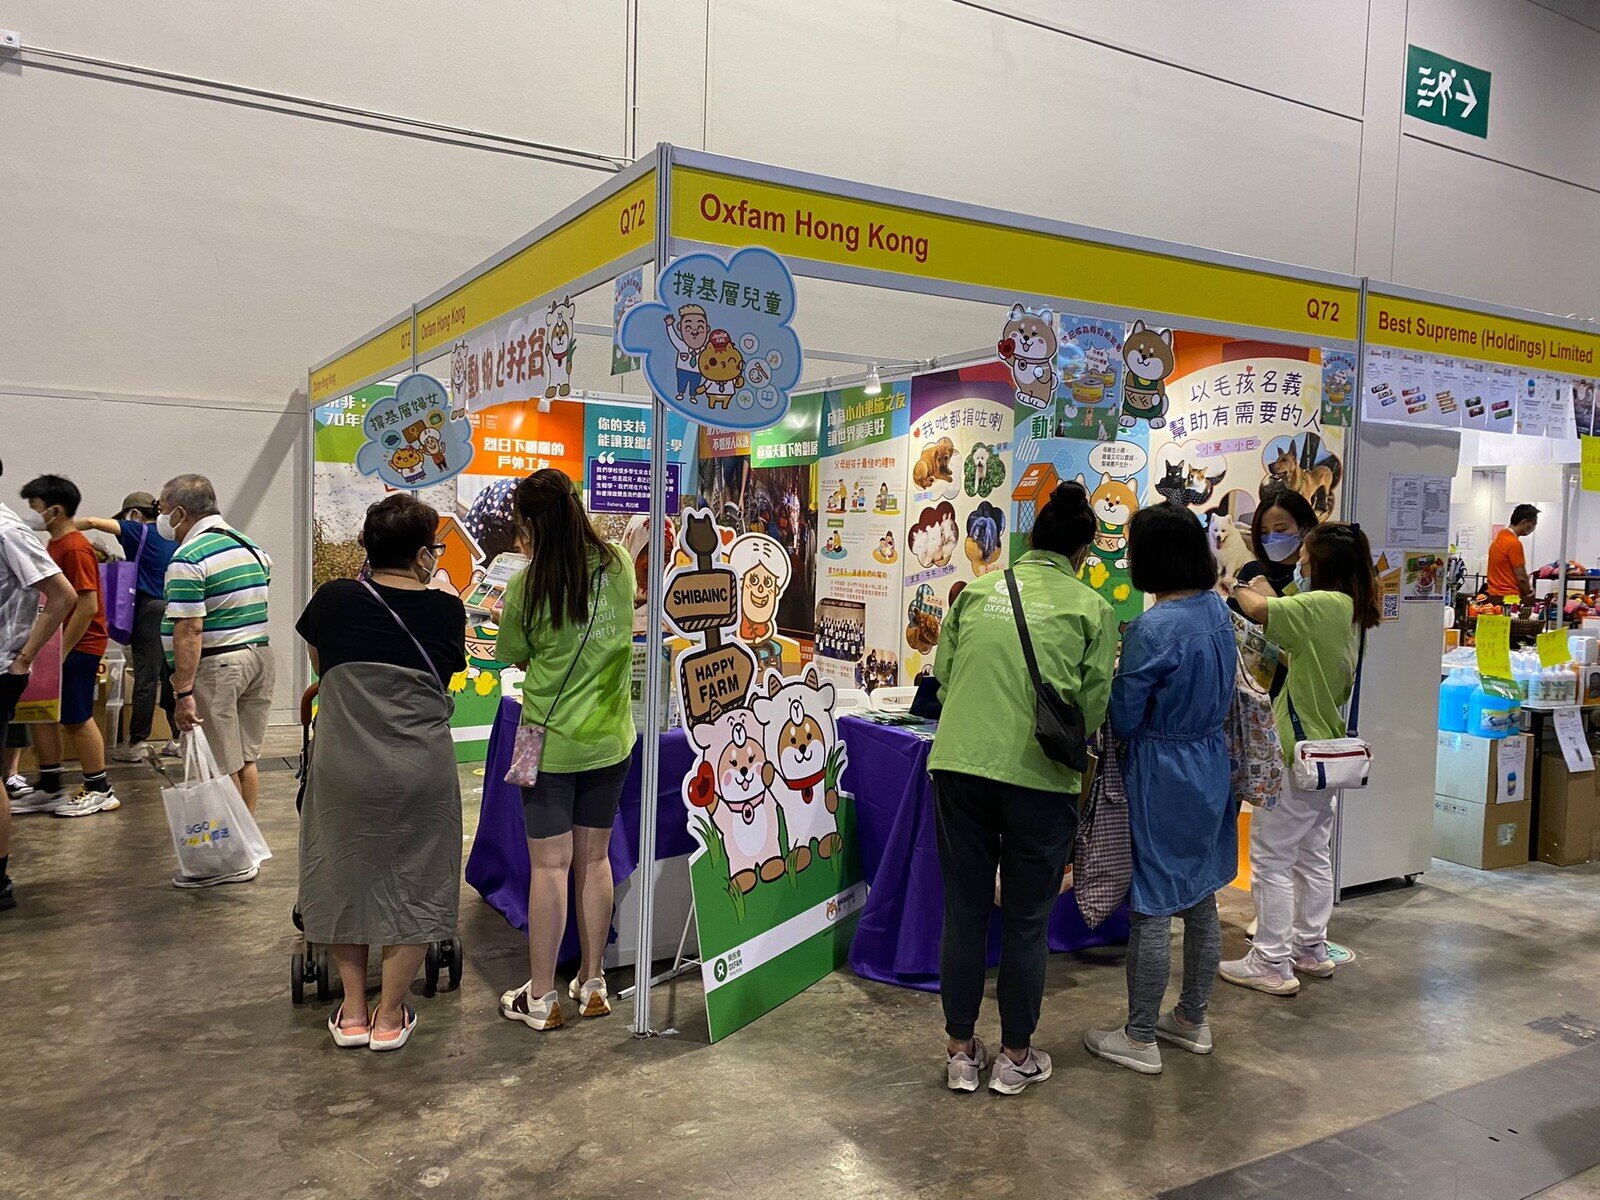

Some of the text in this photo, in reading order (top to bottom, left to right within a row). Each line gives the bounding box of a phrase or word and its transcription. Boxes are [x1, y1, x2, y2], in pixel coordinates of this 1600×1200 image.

[620, 198, 645, 234] Q72
[700, 193, 929, 263] Oxfam Hong Kong
[673, 270, 782, 316] 撐基層兒童
[421, 305, 466, 340] Oxfam Hong Kong
[1306, 298, 1340, 323] Q72
[400, 331, 411, 350] Q72
[1378, 311, 1594, 364] Best Supreme (Holdings) Limited
[1191, 370, 1303, 402] 以毛孩名義
[323, 412, 365, 427] 70年
[369, 392, 440, 431] 撐基層婦女
[597, 417, 647, 434] 你的支持
[1169, 401, 1321, 441] 幫助有需要的人
[828, 417, 885, 447] 讓世界更美好
[673, 587, 728, 606] SHIBAINC
[984, 604, 1014, 615] OXFAM
[695, 656, 735, 682] HAPPY
[699, 674, 740, 704] FARM
